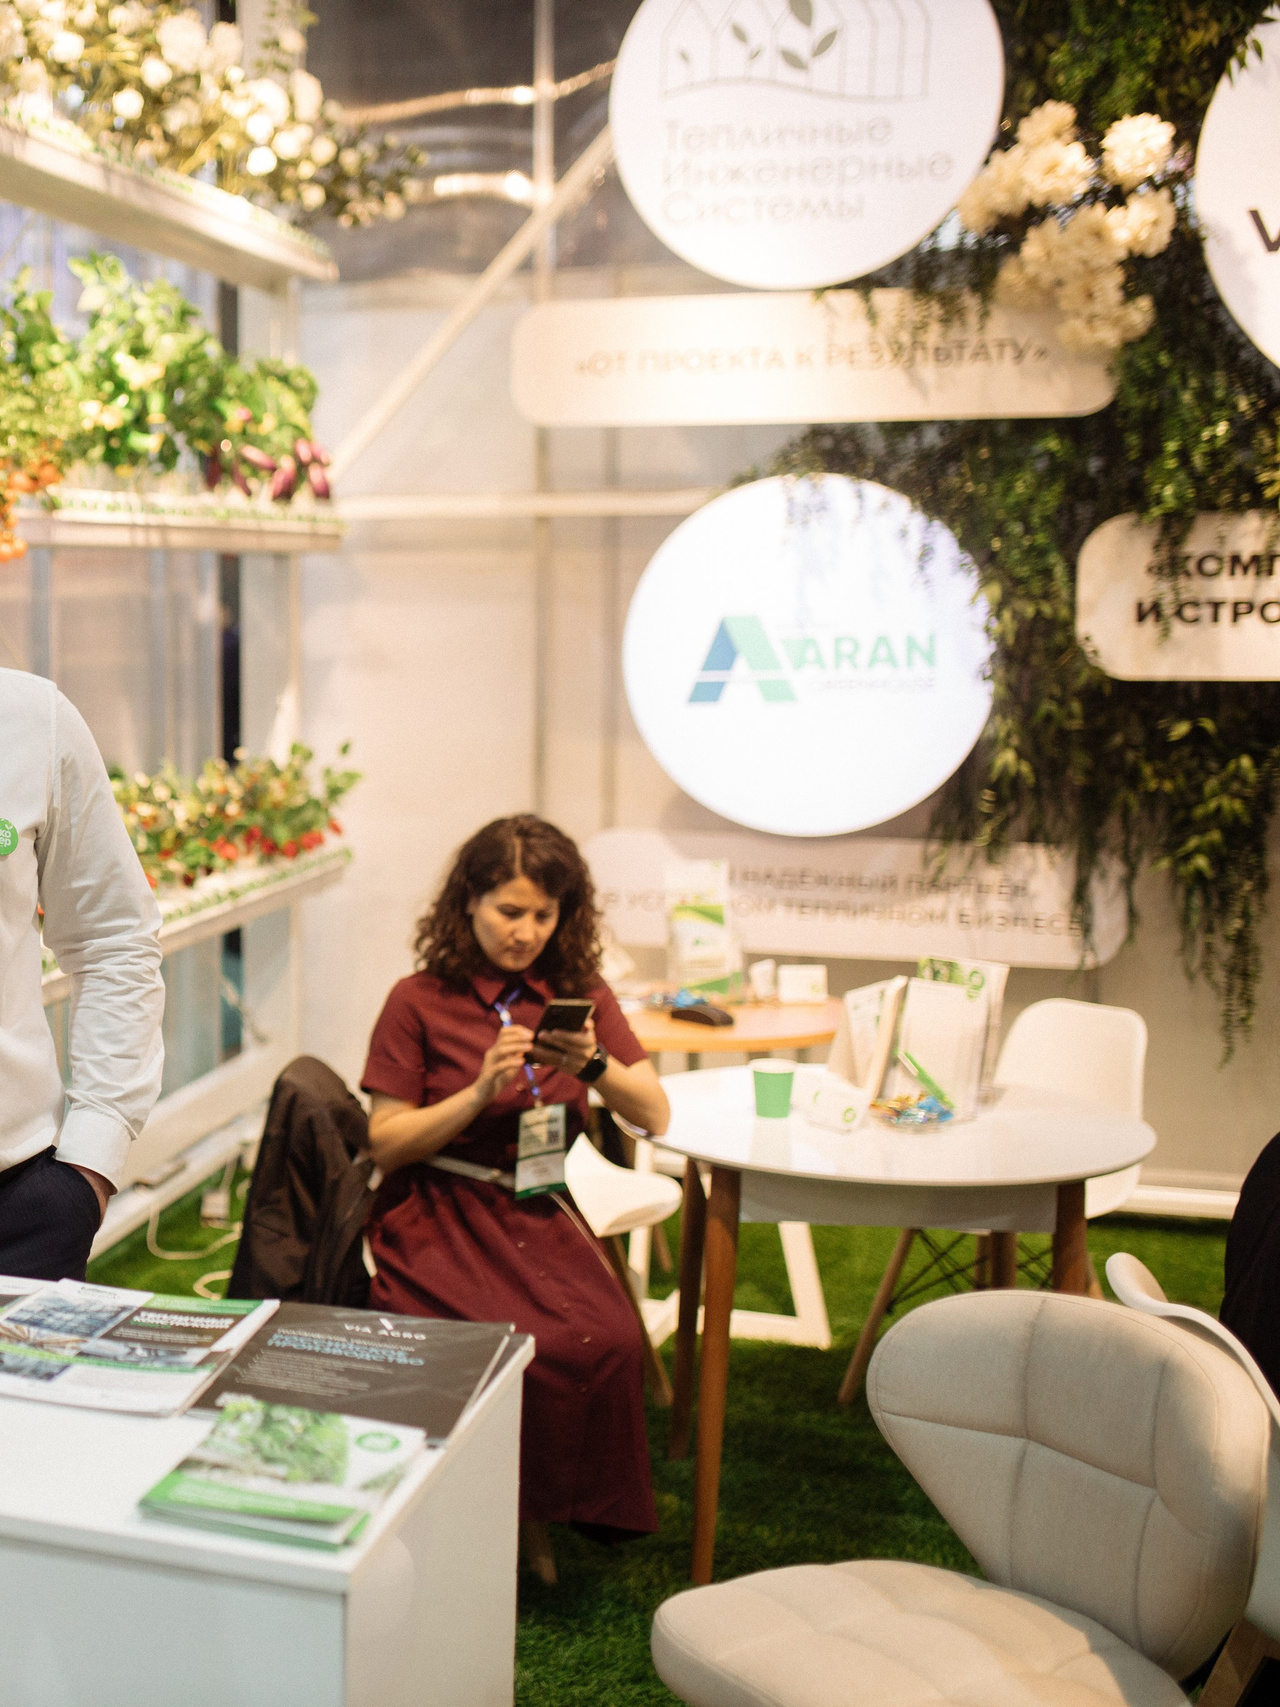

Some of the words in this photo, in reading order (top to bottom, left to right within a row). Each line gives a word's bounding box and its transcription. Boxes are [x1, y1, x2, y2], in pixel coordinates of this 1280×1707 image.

[665, 115, 894, 153] Тепличные
[661, 151, 955, 189] Инженерные
[660, 190, 865, 227] Системы
[637, 346, 786, 374] ПРОЕКТА
[794, 345, 815, 369] К
[1136, 600, 1161, 624] И
[793, 632, 936, 671] ARAN
[344, 1323, 372, 1334] VIA
[376, 1329, 427, 1341] AGRO
